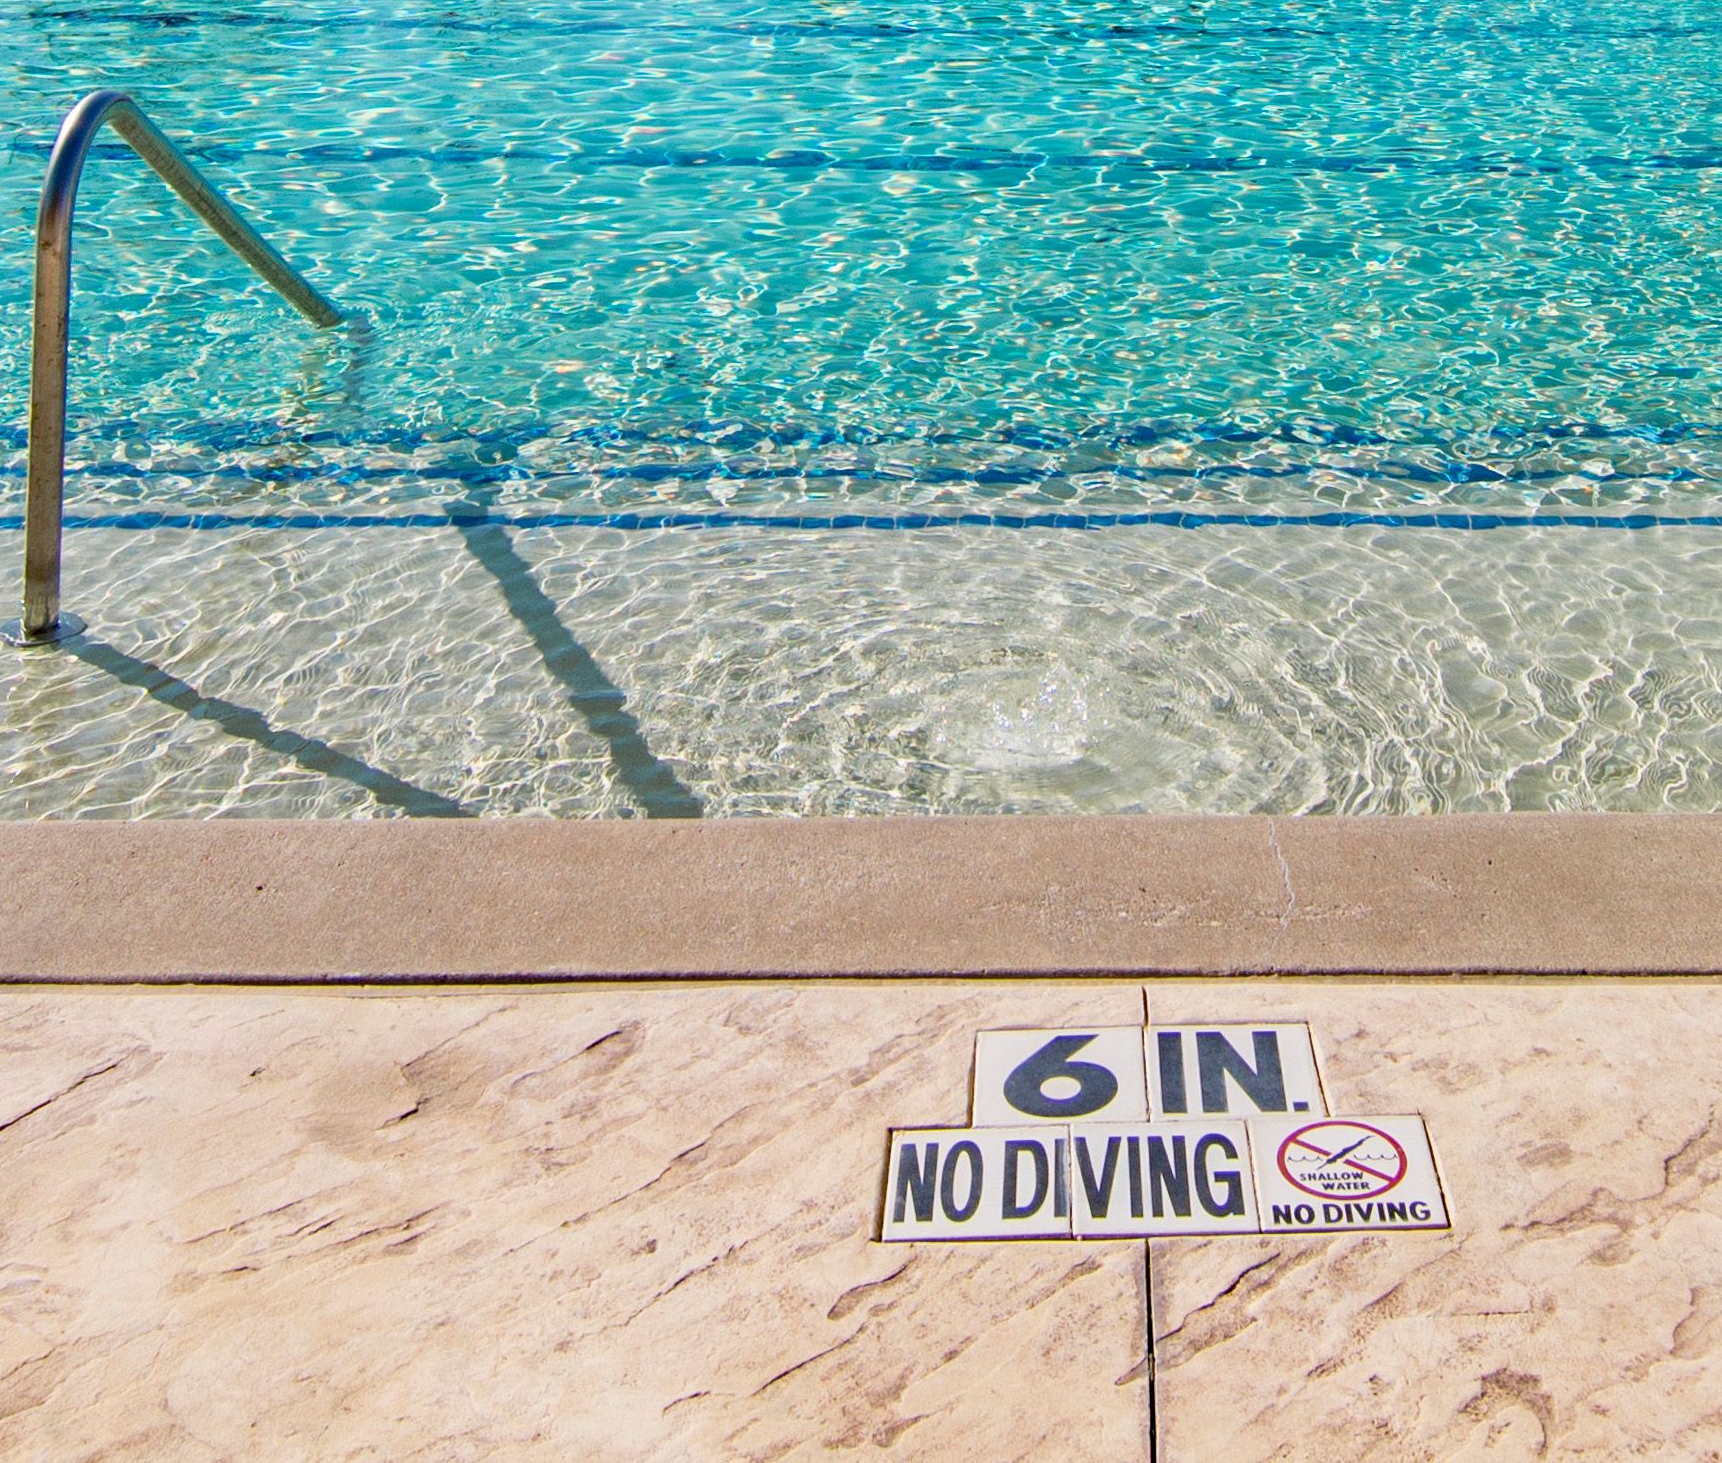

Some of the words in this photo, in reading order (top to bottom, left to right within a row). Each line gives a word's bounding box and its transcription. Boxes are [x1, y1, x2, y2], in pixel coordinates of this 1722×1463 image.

[1003, 1033, 1119, 1118] 6
[1157, 1030, 1310, 1114] IN.
[893, 1139, 985, 1224] NO
[1001, 1132, 1247, 1222] DIVING
[1299, 1171, 1364, 1182] SHALLOW
[1322, 1181, 1371, 1191] WATER
[1272, 1203, 1316, 1225] NO
[1322, 1200, 1432, 1224] DIVING
